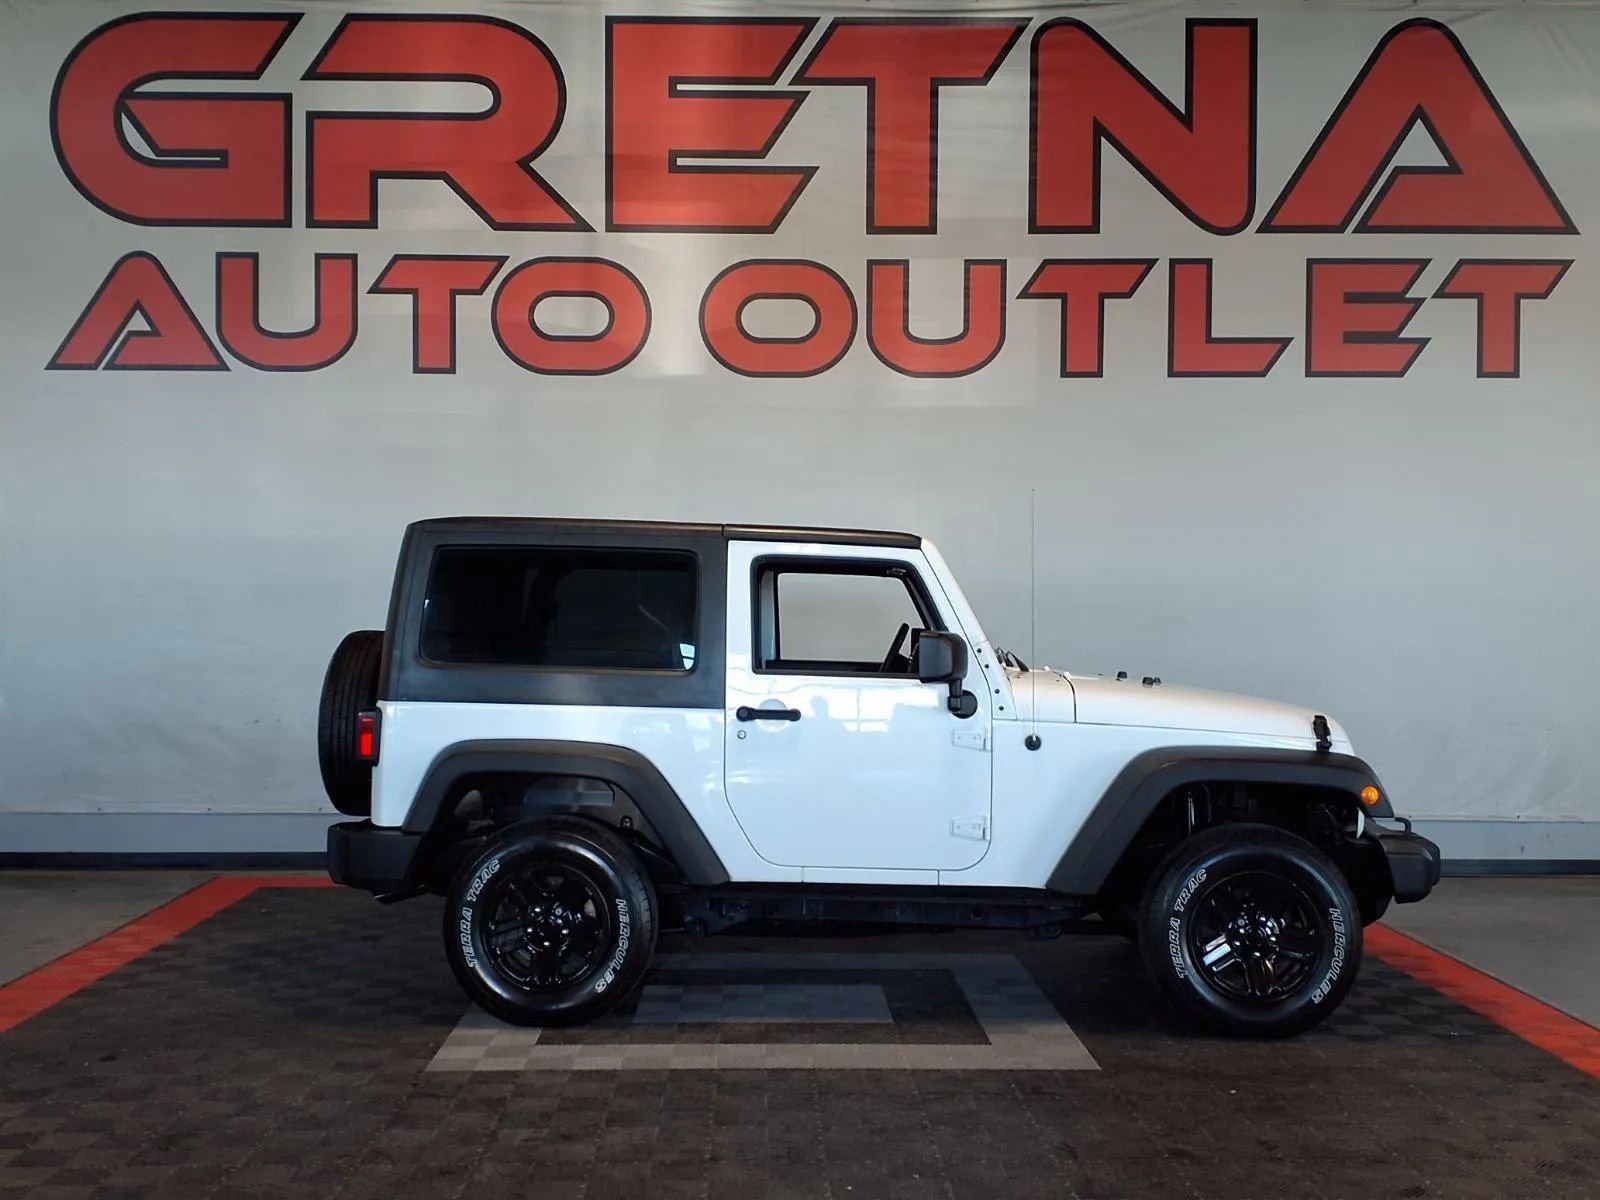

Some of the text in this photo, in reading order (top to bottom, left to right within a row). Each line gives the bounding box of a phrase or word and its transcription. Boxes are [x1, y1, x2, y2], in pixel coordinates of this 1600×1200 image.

[49, 11, 1580, 236] GRETNA
[44, 250, 1576, 379] AUTO OUTLET
[460, 859, 500, 968] TERRA TRAC
[595, 898, 630, 993] HERCULES
[1169, 869, 1207, 979] TERRA TRAC
[1311, 908, 1346, 1004] HERCULES
